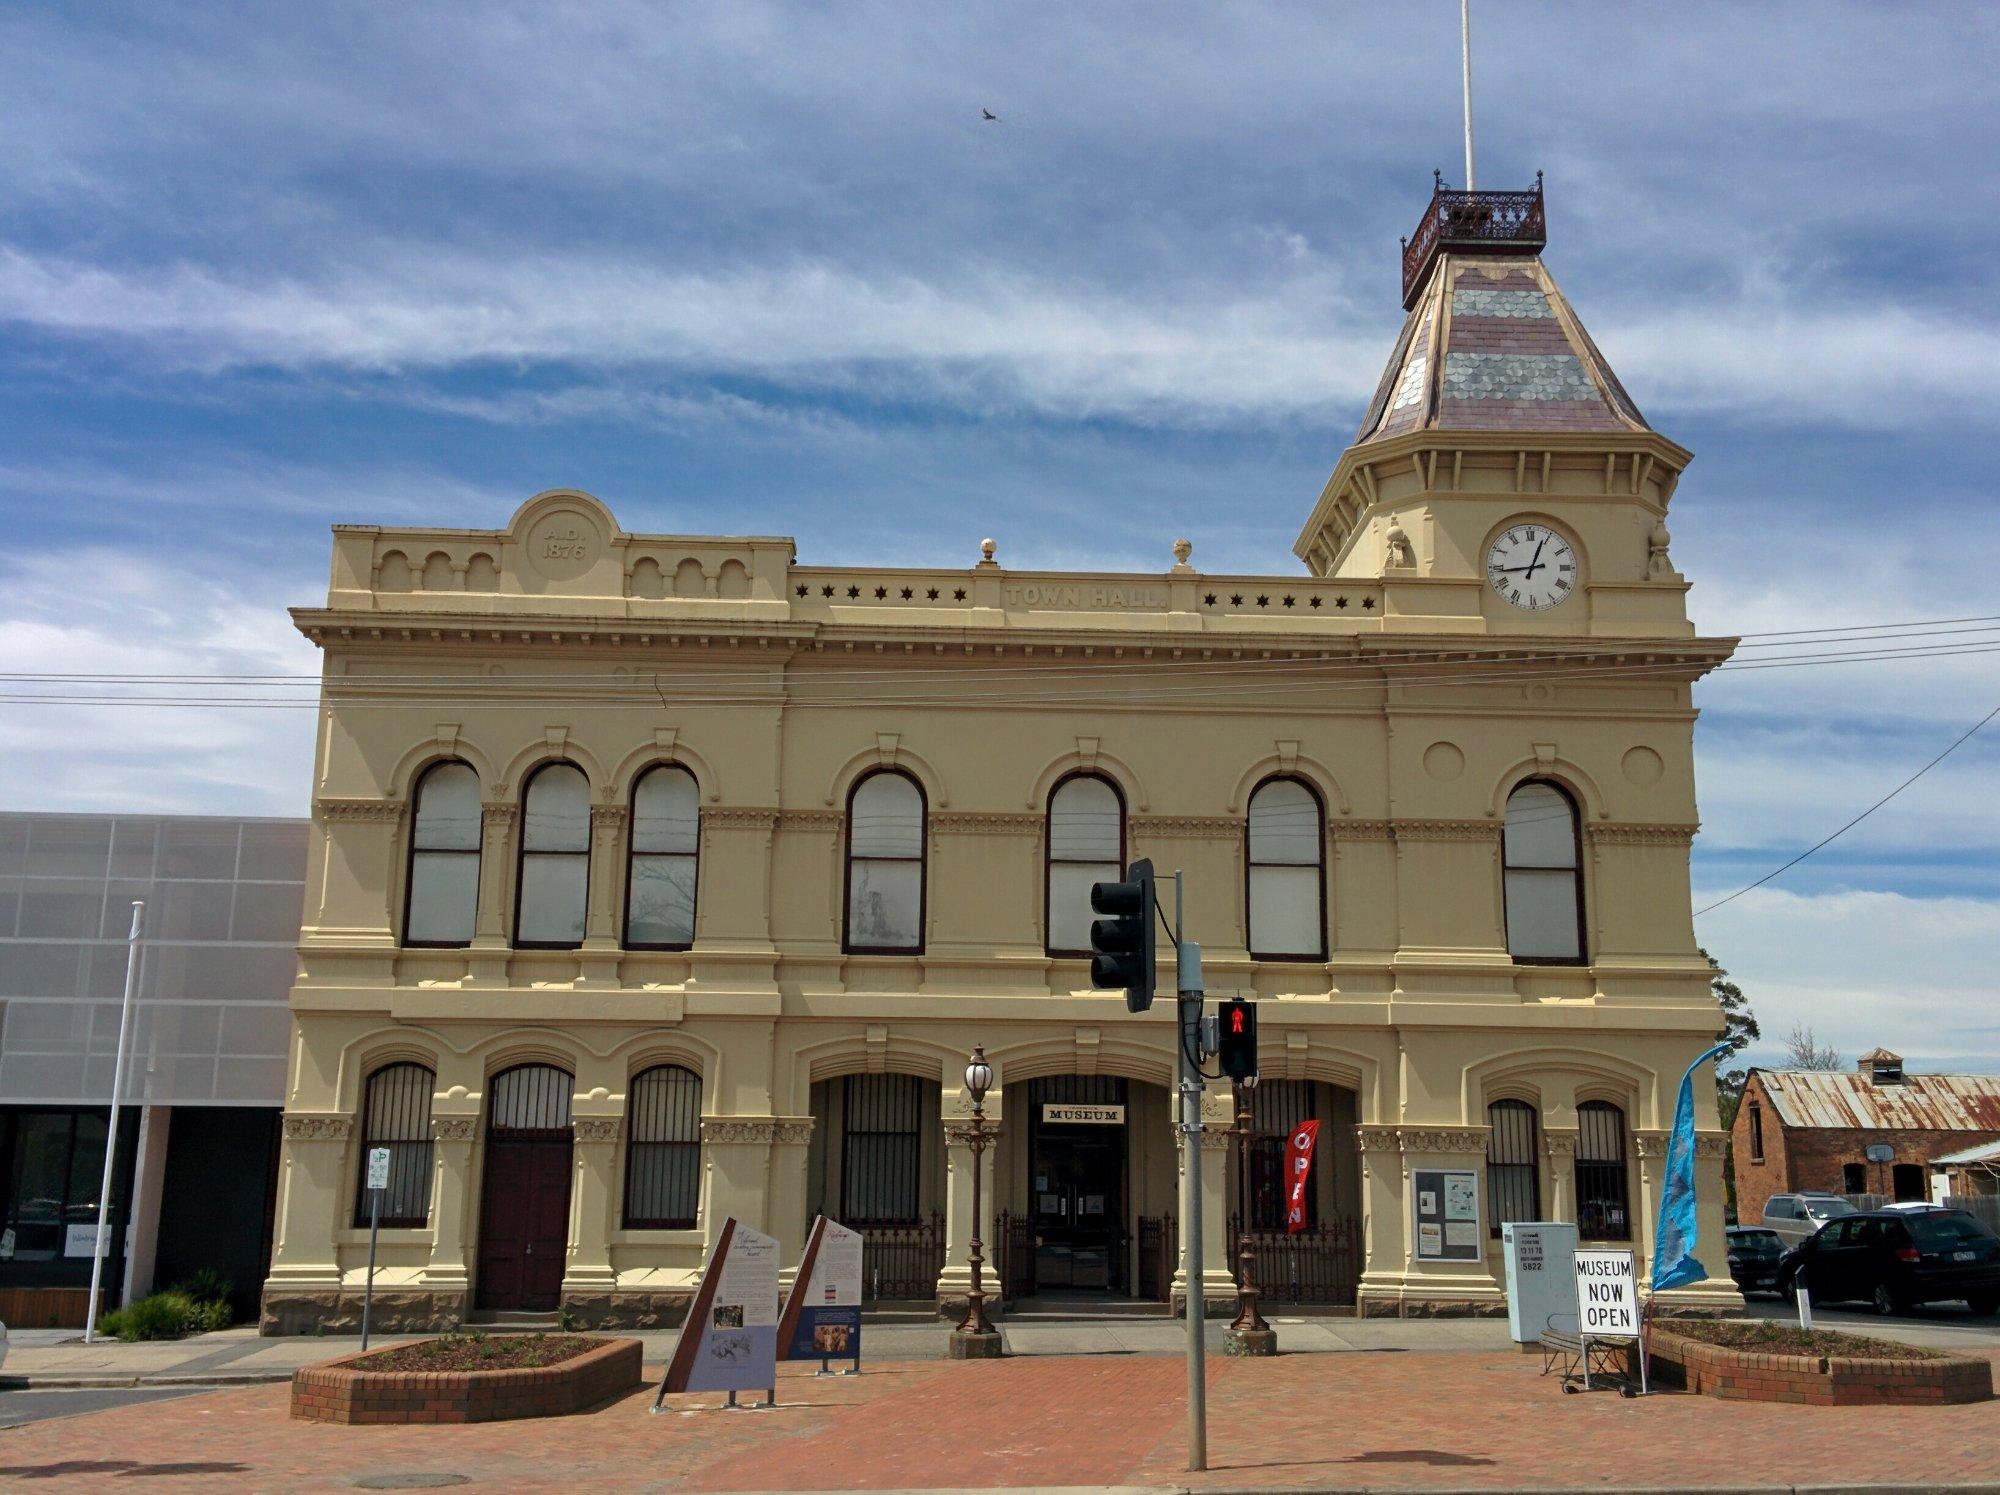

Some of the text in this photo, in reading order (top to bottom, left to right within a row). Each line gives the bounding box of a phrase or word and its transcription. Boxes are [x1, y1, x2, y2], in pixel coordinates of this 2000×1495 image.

[1005, 585, 1080, 607] TOWN
[1049, 1110, 1118, 1120] MUSEUM
[1288, 1132, 1312, 1224] OPEN
[1576, 1260, 1632, 1277] MUSEUM
[1588, 1283, 1623, 1303] NOW
[1587, 1307, 1630, 1327] OPEN
